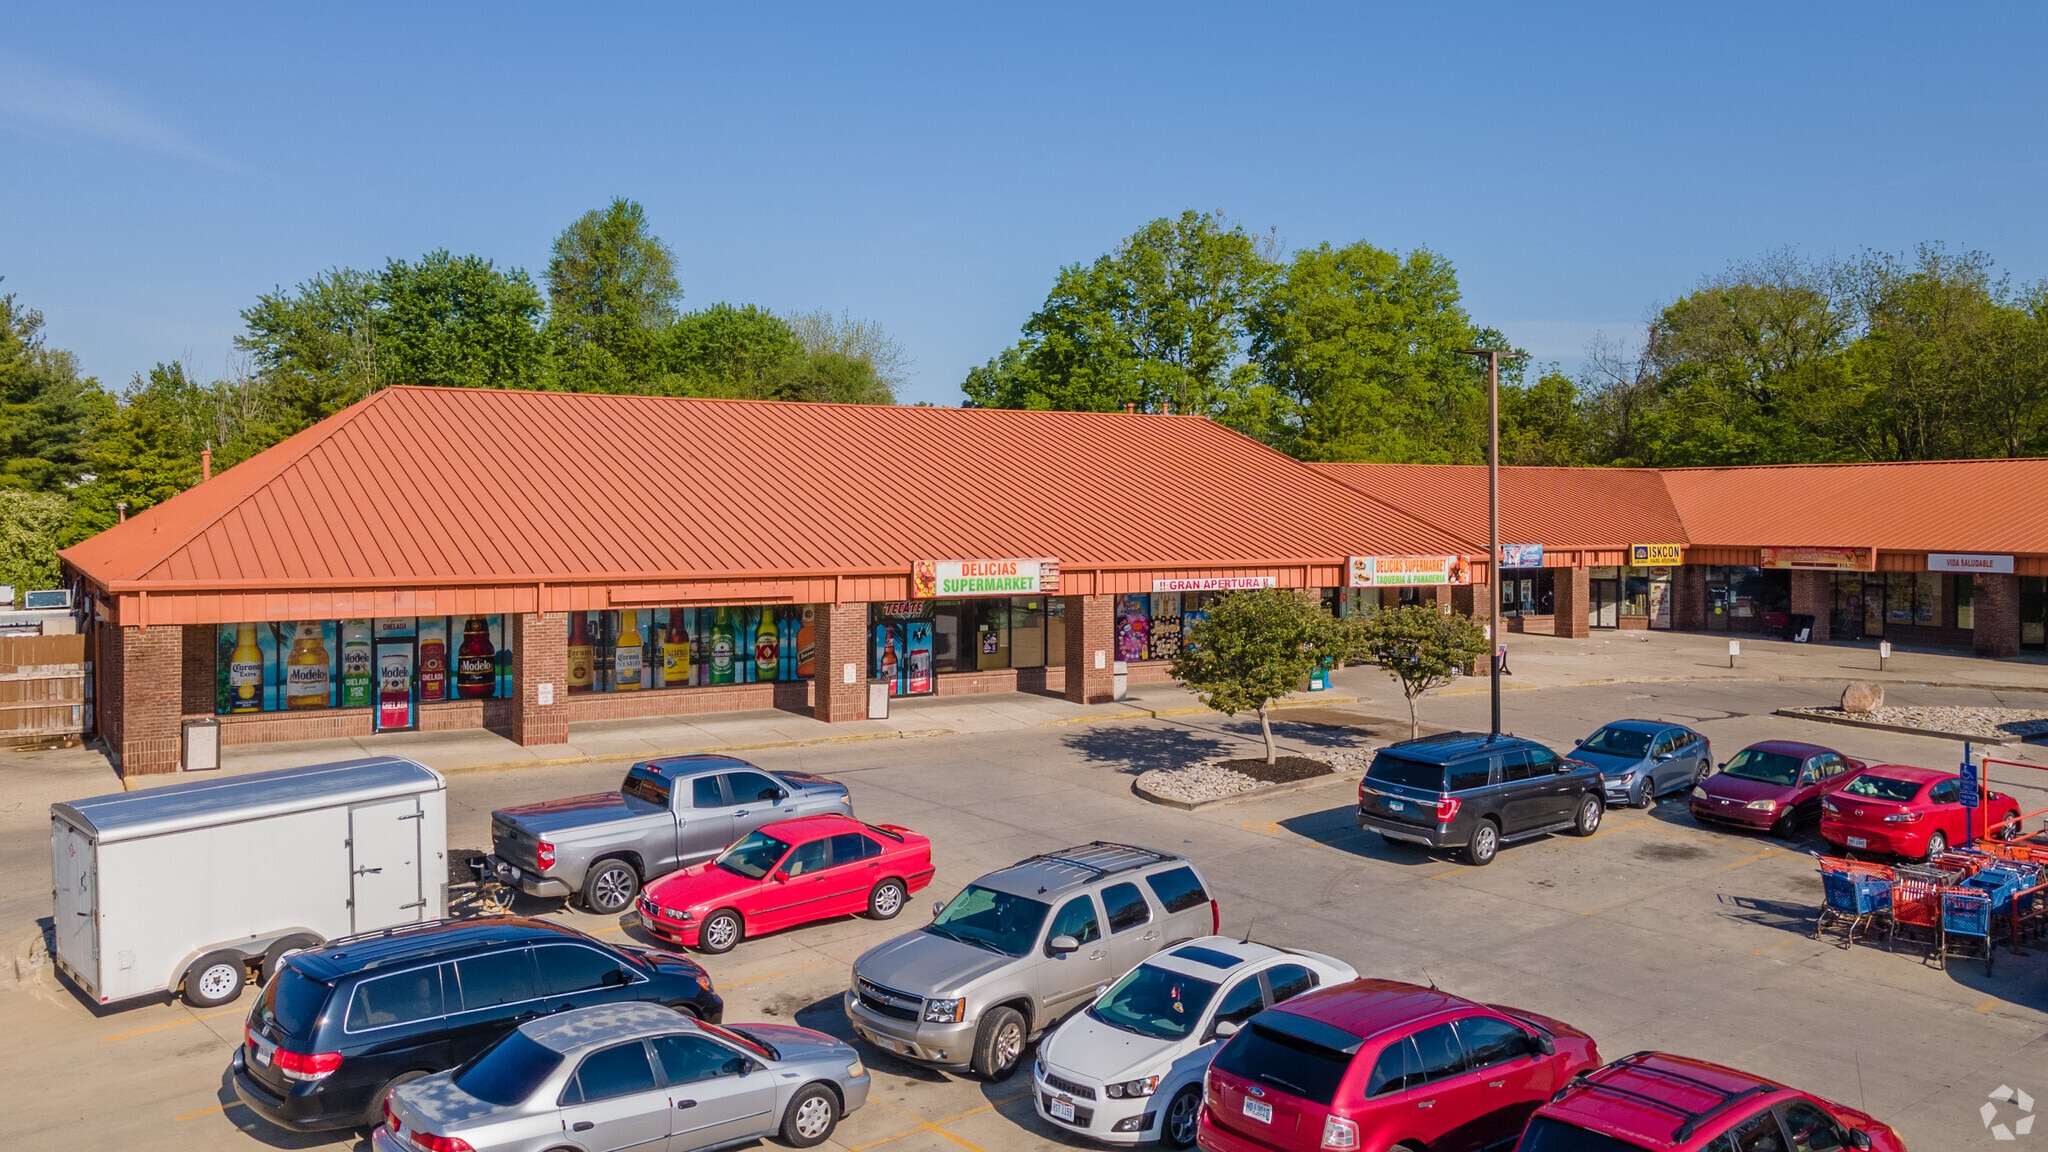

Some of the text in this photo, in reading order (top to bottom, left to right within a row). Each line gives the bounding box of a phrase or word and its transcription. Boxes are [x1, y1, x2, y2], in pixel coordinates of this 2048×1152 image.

[1649, 546, 1679, 558] ISKCON
[1376, 559, 1447, 573] DELICIAS SUPERMARKET
[1946, 559, 1994, 568] VIDA SALUDABLE
[961, 562, 1017, 577] DELICIAS
[943, 576, 1034, 593] SUPERMARKET
[1169, 580, 1200, 590] GRAN
[1203, 578, 1260, 589] APERTURA
[1376, 574, 1446, 585] TAQUERIA & PANADERIA
[885, 601, 923, 615] TECATE
[383, 623, 407, 631] CHELADA
[618, 653, 640, 662] Corona
[232, 663, 261, 673] Corona
[462, 660, 491, 671] Modelo
[292, 669, 325, 680] Modelo
[345, 678, 369, 686] CHELADA
[382, 701, 408, 710] CHELADA
